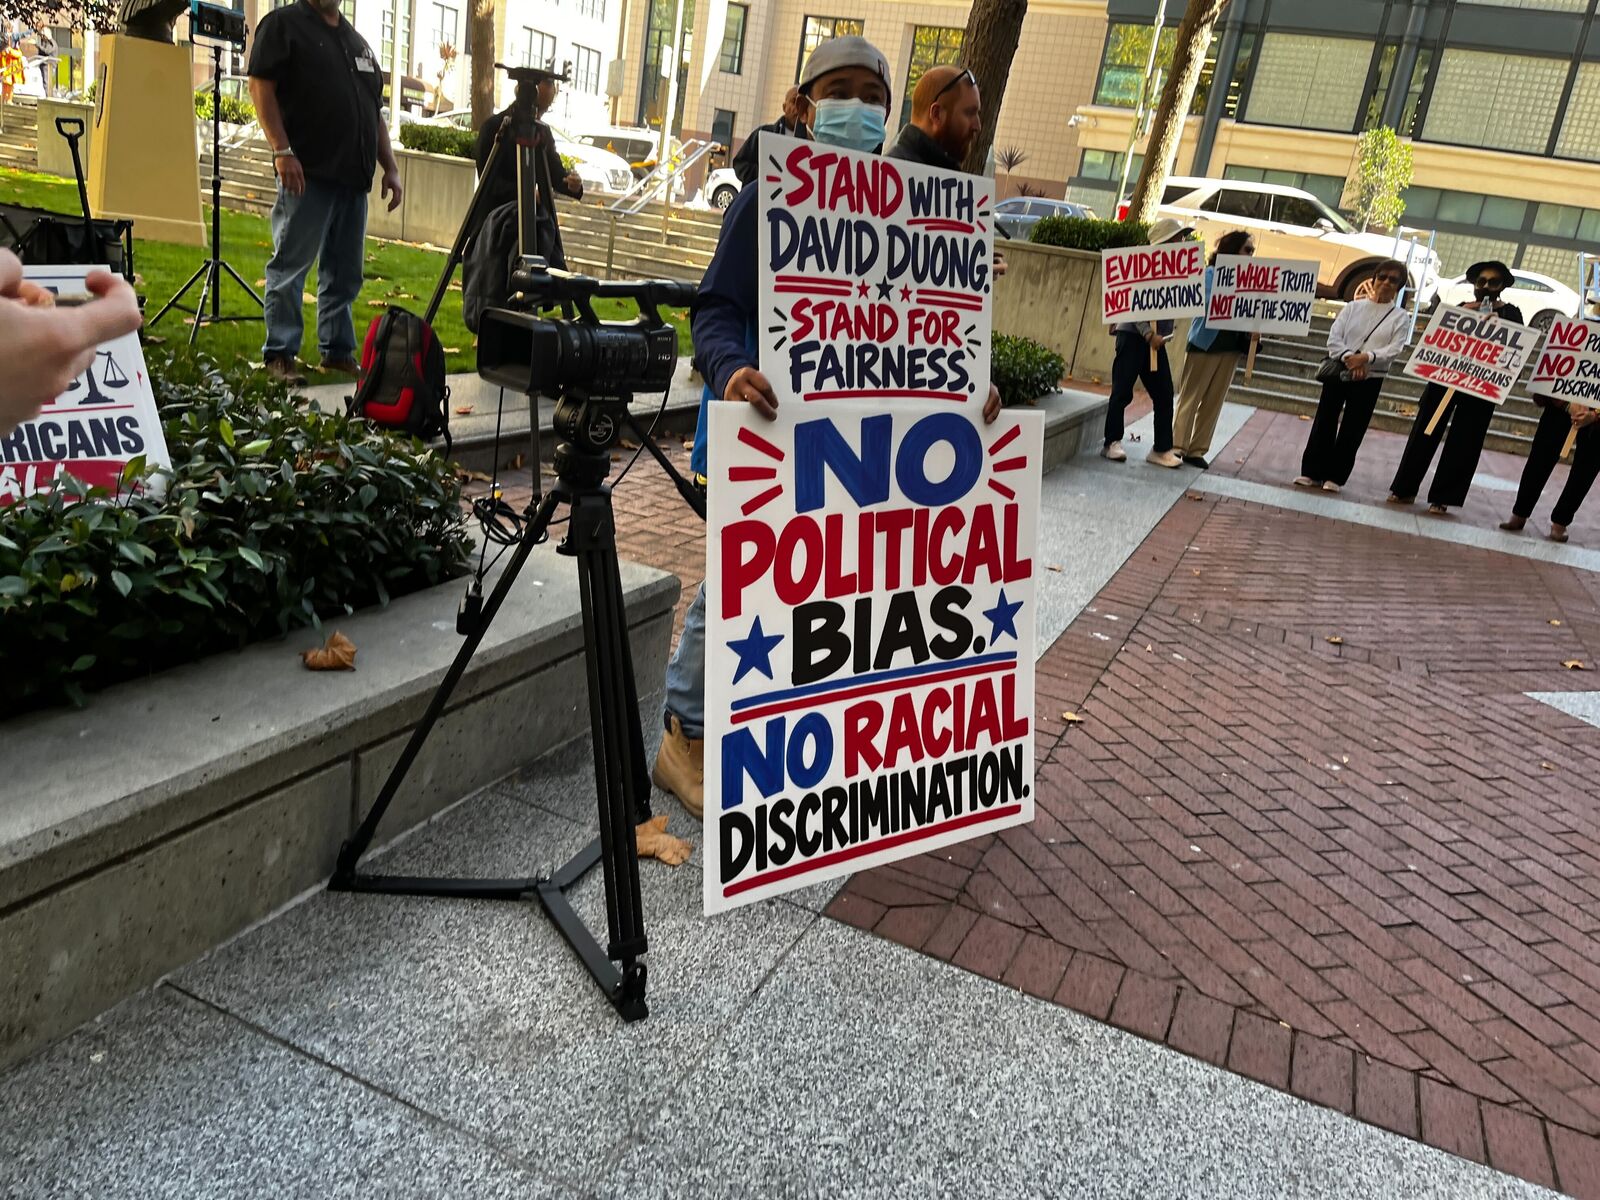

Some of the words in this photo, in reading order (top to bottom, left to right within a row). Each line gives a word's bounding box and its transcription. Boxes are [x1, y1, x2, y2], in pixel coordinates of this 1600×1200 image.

[785, 145, 904, 219] STAND
[908, 176, 974, 223] WITH
[767, 207, 879, 277] DAVID
[886, 224, 990, 294] DUONG.
[1106, 247, 1203, 283] EVIDENCE,
[1105, 287, 1131, 312] NOT
[1132, 283, 1204, 312] ACCUSATIONS.
[1217, 266, 1235, 287] THE
[1236, 263, 1280, 290] WHOLE
[1281, 270, 1314, 293] TRUTH.
[790, 298, 898, 343] STAND
[907, 309, 963, 347] FOR
[1210, 294, 1235, 316] NOT
[1234, 297, 1261, 318] HALF
[1261, 300, 1279, 319] THE
[1278, 299, 1311, 323] STORY.
[1423, 328, 1505, 365] JUSTICE
[1439, 310, 1524, 351] EQUAL
[1549, 321, 1588, 347] NO
[789, 341, 976, 394] FAIRNESS.
[1415, 347, 1451, 370] ASIAN
[1449, 358, 1513, 388] AMERICANS
[1428, 368, 1460, 383] AND
[1537, 353, 1576, 377] NO
[794, 412, 983, 514] NO
[721, 503, 1032, 619] POLITICAL
[791, 586, 987, 686] BIAS.
[721, 711, 834, 810] NO
[844, 673, 1029, 779] RACIAL
[719, 743, 1031, 885] DISCRIMINATION.
